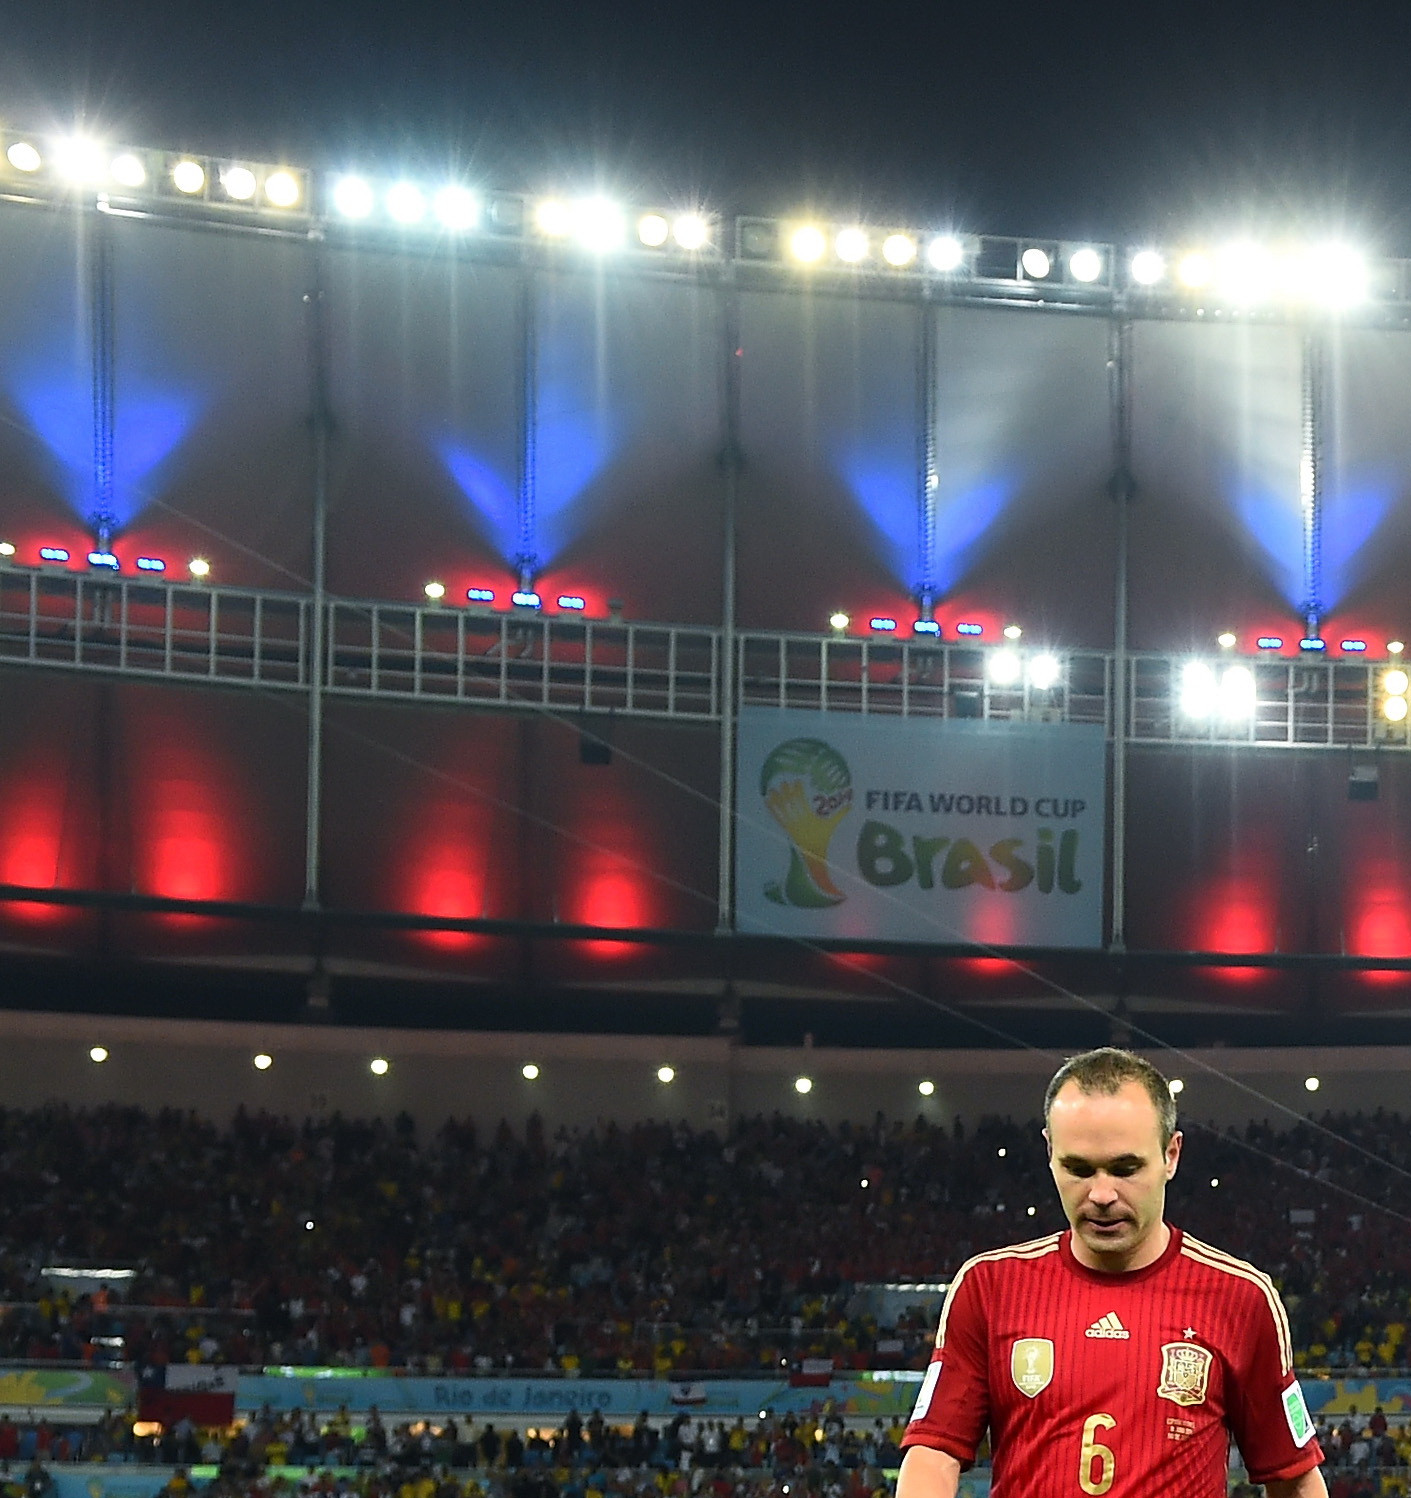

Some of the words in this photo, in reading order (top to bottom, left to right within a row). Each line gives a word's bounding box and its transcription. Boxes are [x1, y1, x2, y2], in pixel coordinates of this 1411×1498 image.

[865, 789, 925, 815] FIFA
[928, 792, 1028, 817] WORLD
[1034, 797, 1087, 819] CUP
[856, 819, 1083, 895] Brasil
[1085, 1328, 1130, 1340] adidas
[1079, 1413, 1117, 1496] 6
